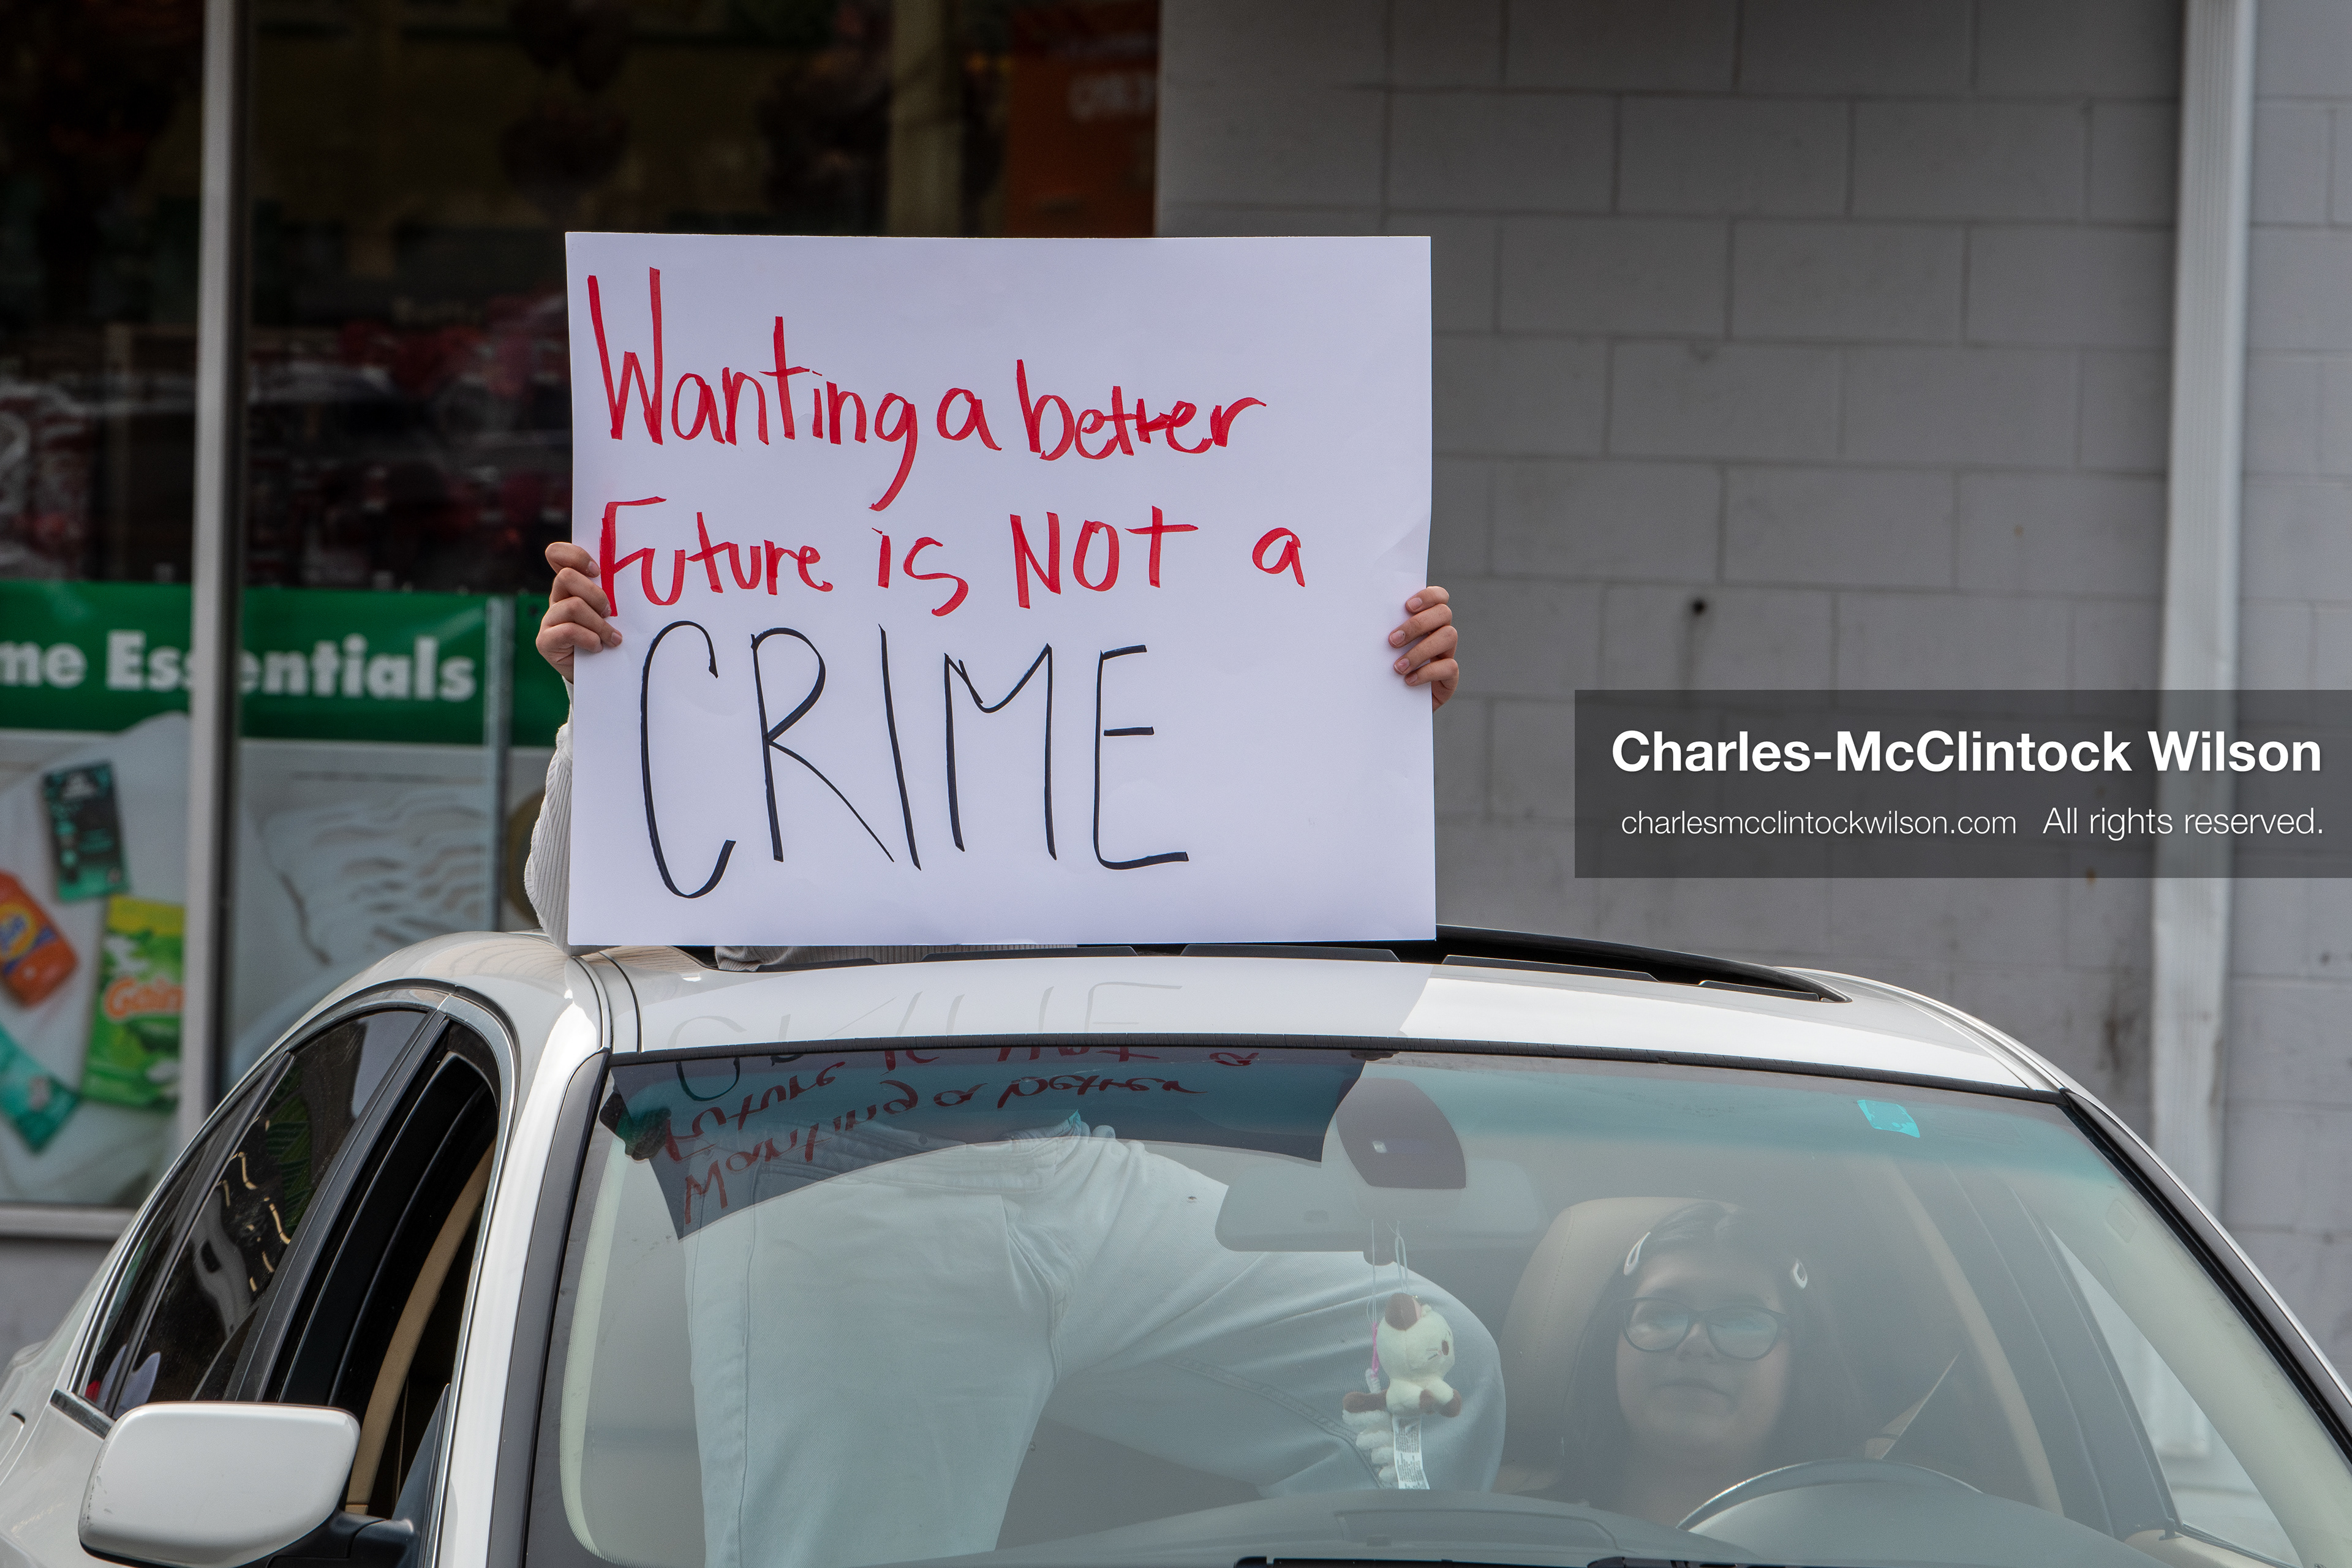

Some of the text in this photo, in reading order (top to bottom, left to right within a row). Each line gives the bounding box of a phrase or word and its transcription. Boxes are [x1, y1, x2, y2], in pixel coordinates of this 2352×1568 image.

[587, 266, 1267, 511] Wanting a better
[599, 496, 1306, 617] Future is NOT a
[639, 619, 1190, 900] CRIME
